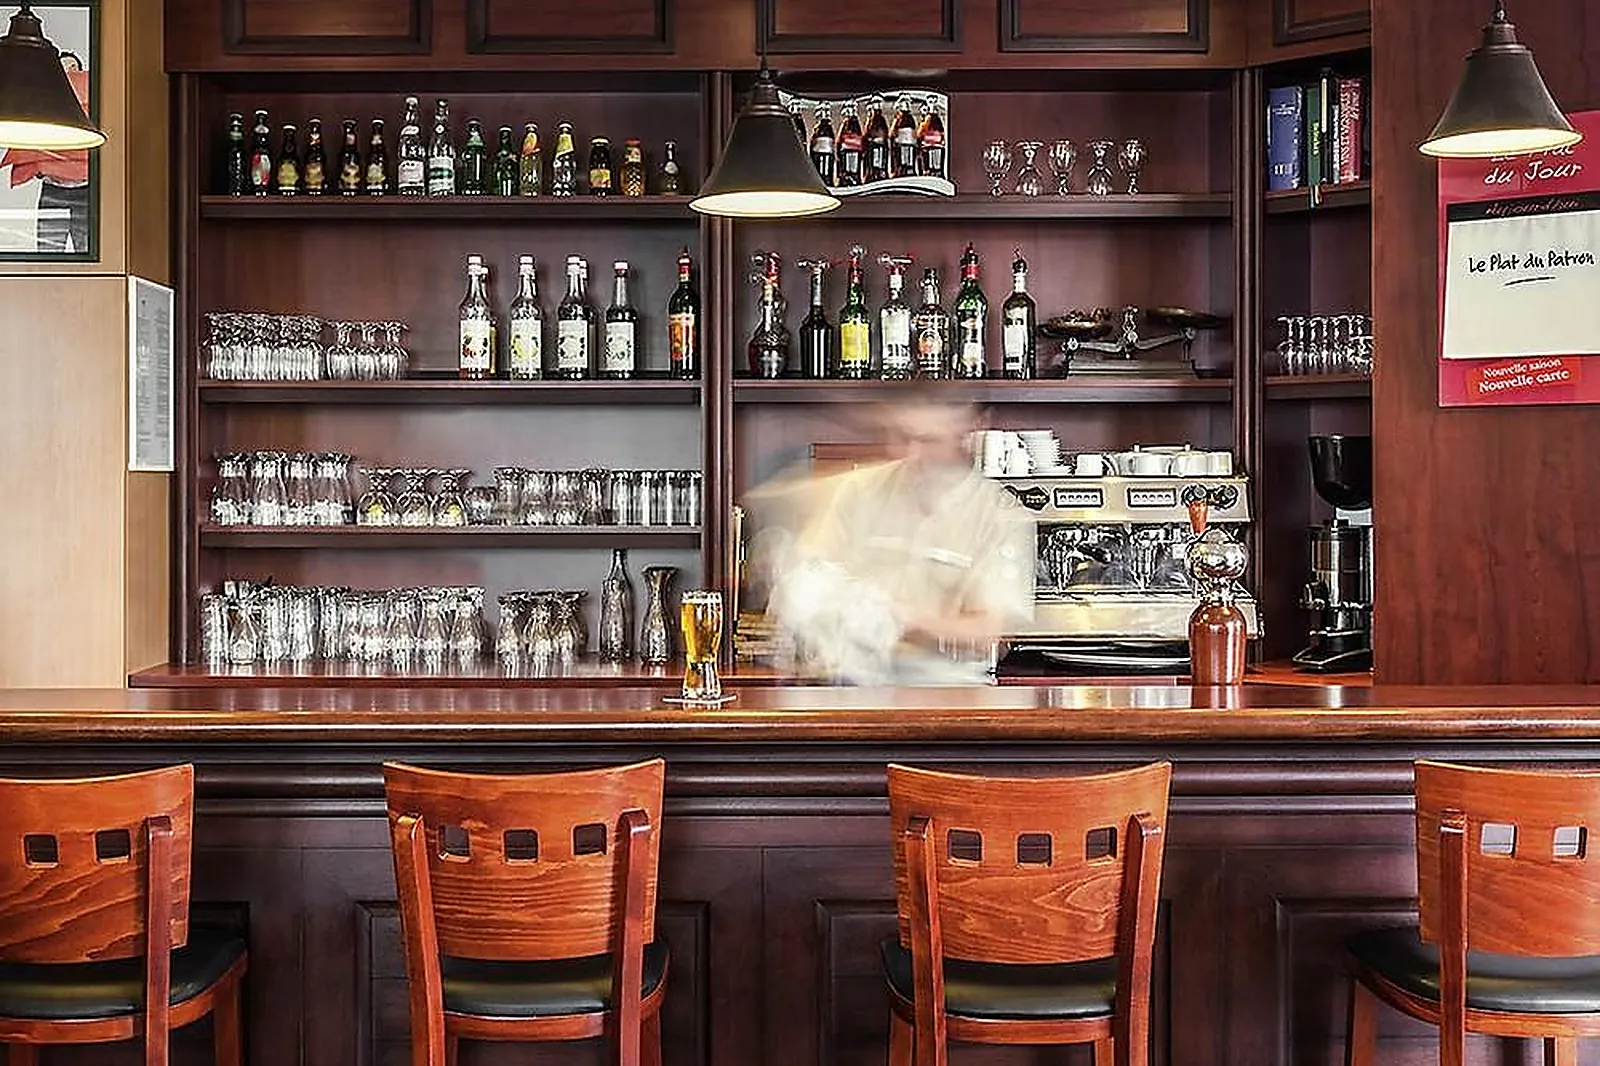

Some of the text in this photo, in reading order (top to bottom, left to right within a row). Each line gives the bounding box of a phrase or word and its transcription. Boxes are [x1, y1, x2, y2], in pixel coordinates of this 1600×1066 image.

[1484, 160, 1582, 185] du Jour
[1469, 250, 1594, 273] Le Plat du Patron
[1484, 358, 1562, 379] Nouvelle saison
[1480, 370, 1570, 393] Nouvelle carte
